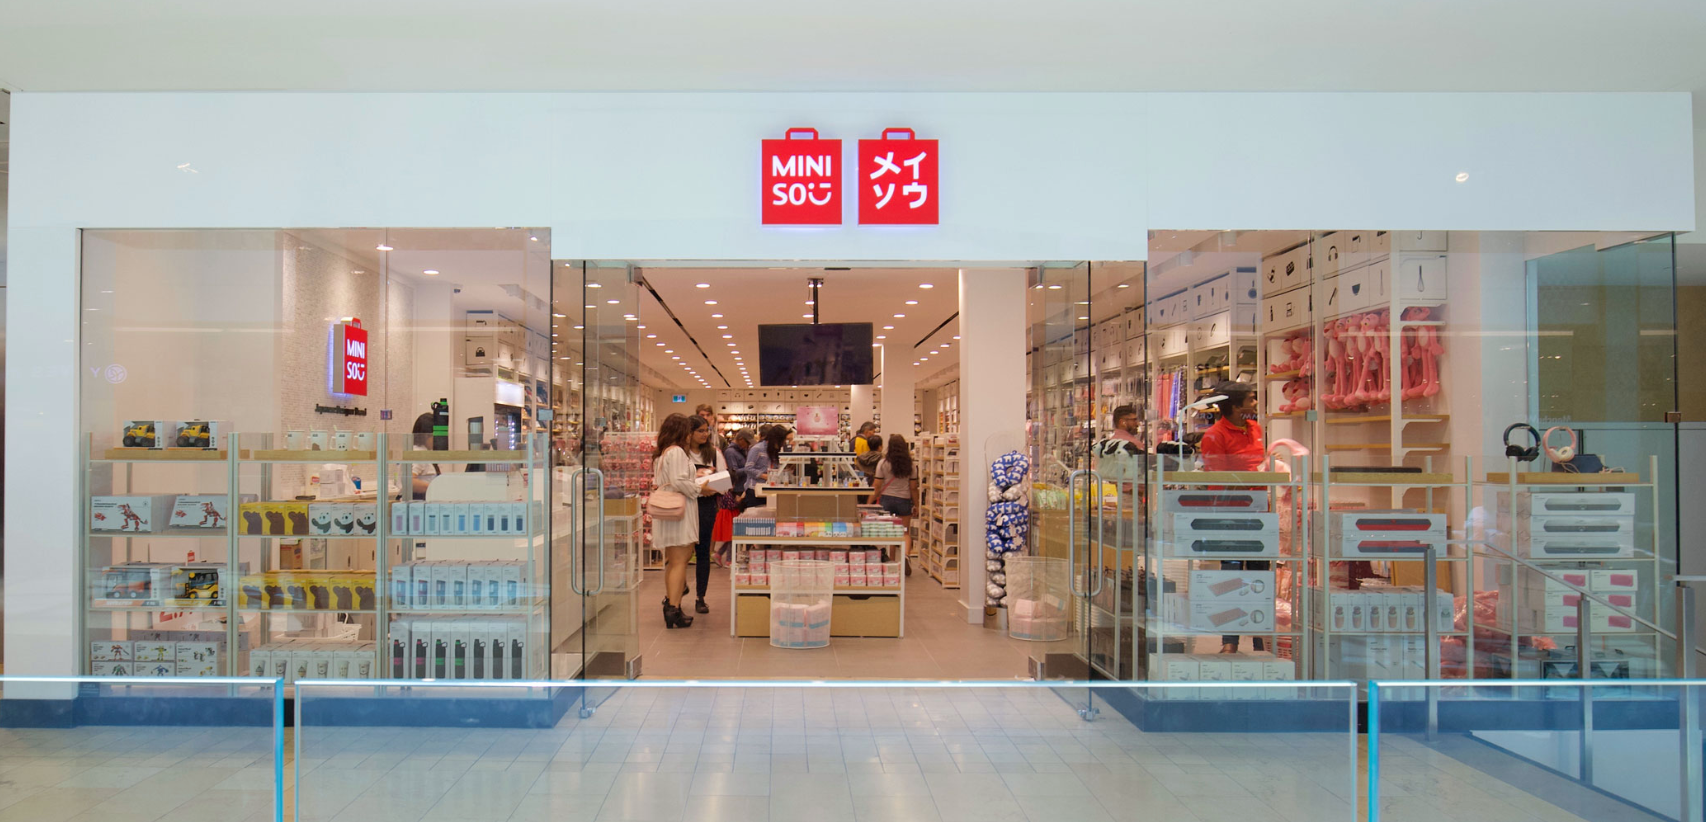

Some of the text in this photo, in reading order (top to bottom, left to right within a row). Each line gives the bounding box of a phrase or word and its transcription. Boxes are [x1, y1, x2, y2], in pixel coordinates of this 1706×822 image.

[772, 155, 831, 177] MINI
[869, 151, 927, 180] メイ
[873, 182, 928, 210] ソウ
[346, 338, 365, 359] MINI
